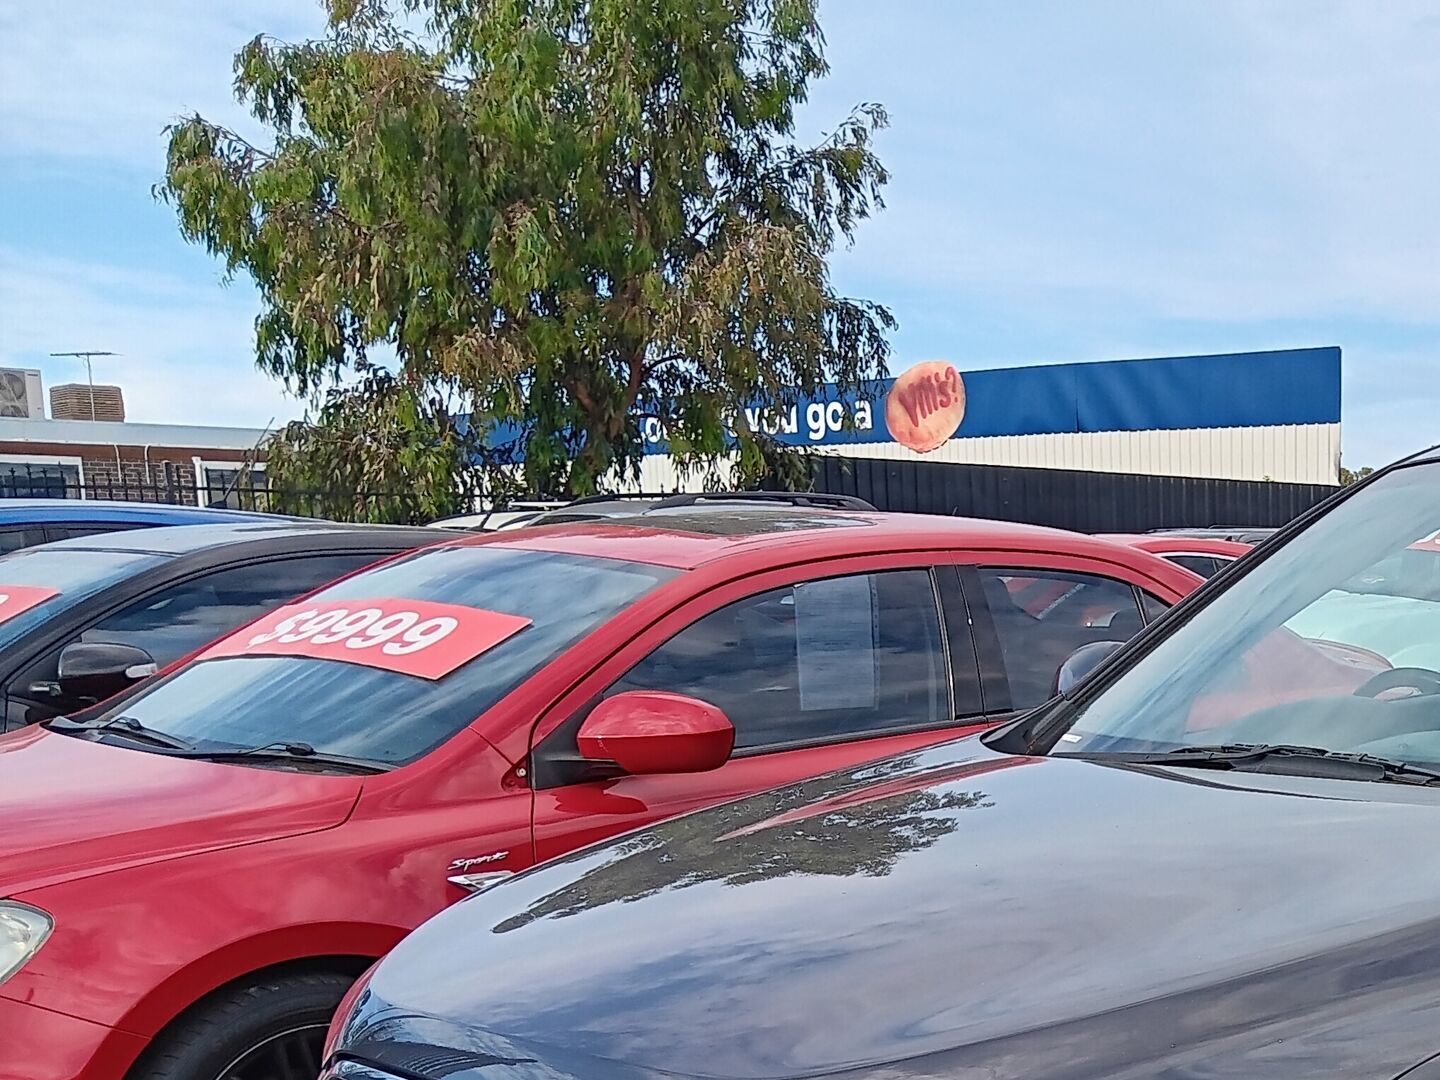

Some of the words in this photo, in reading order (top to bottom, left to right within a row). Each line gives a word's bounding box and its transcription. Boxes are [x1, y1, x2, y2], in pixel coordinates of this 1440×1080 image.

[806, 401, 844, 440] go
[854, 400, 873, 430] a
[247, 607, 459, 655] $9999
[447, 851, 510, 872] Sport
